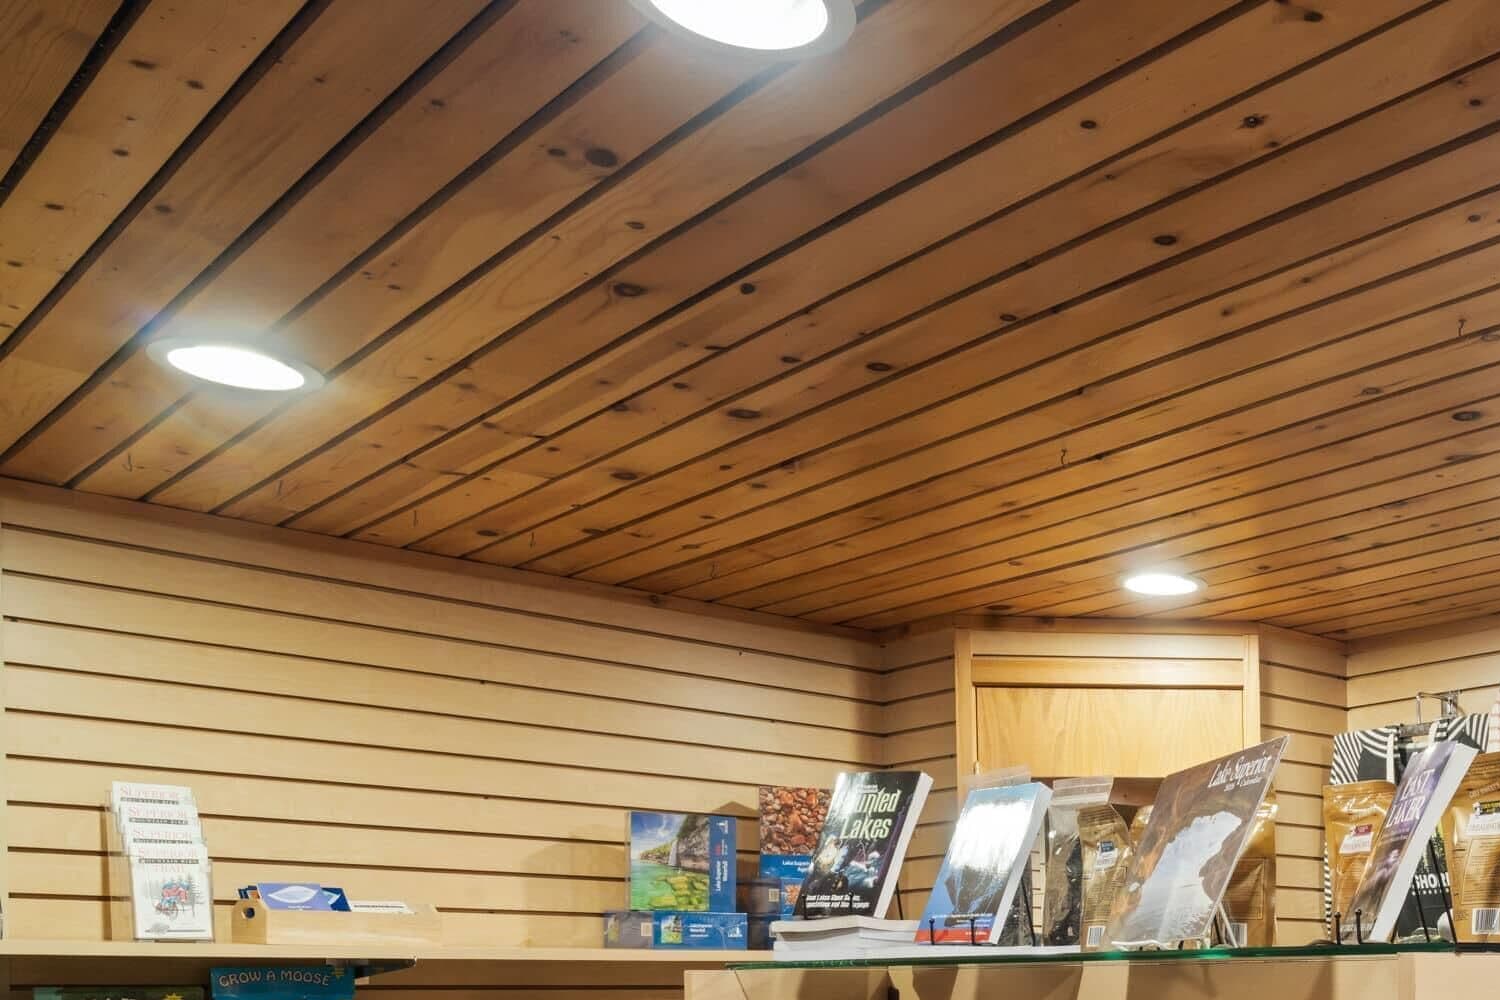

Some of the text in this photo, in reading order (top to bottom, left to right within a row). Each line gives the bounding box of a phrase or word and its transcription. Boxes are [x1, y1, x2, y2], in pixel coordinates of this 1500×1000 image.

[129, 806, 187, 819] SUPERIOR
[133, 827, 192, 839] SUPERIOR
[840, 815, 892, 841] Lakes
[218, 970, 331, 988] GROW A MOOSE
